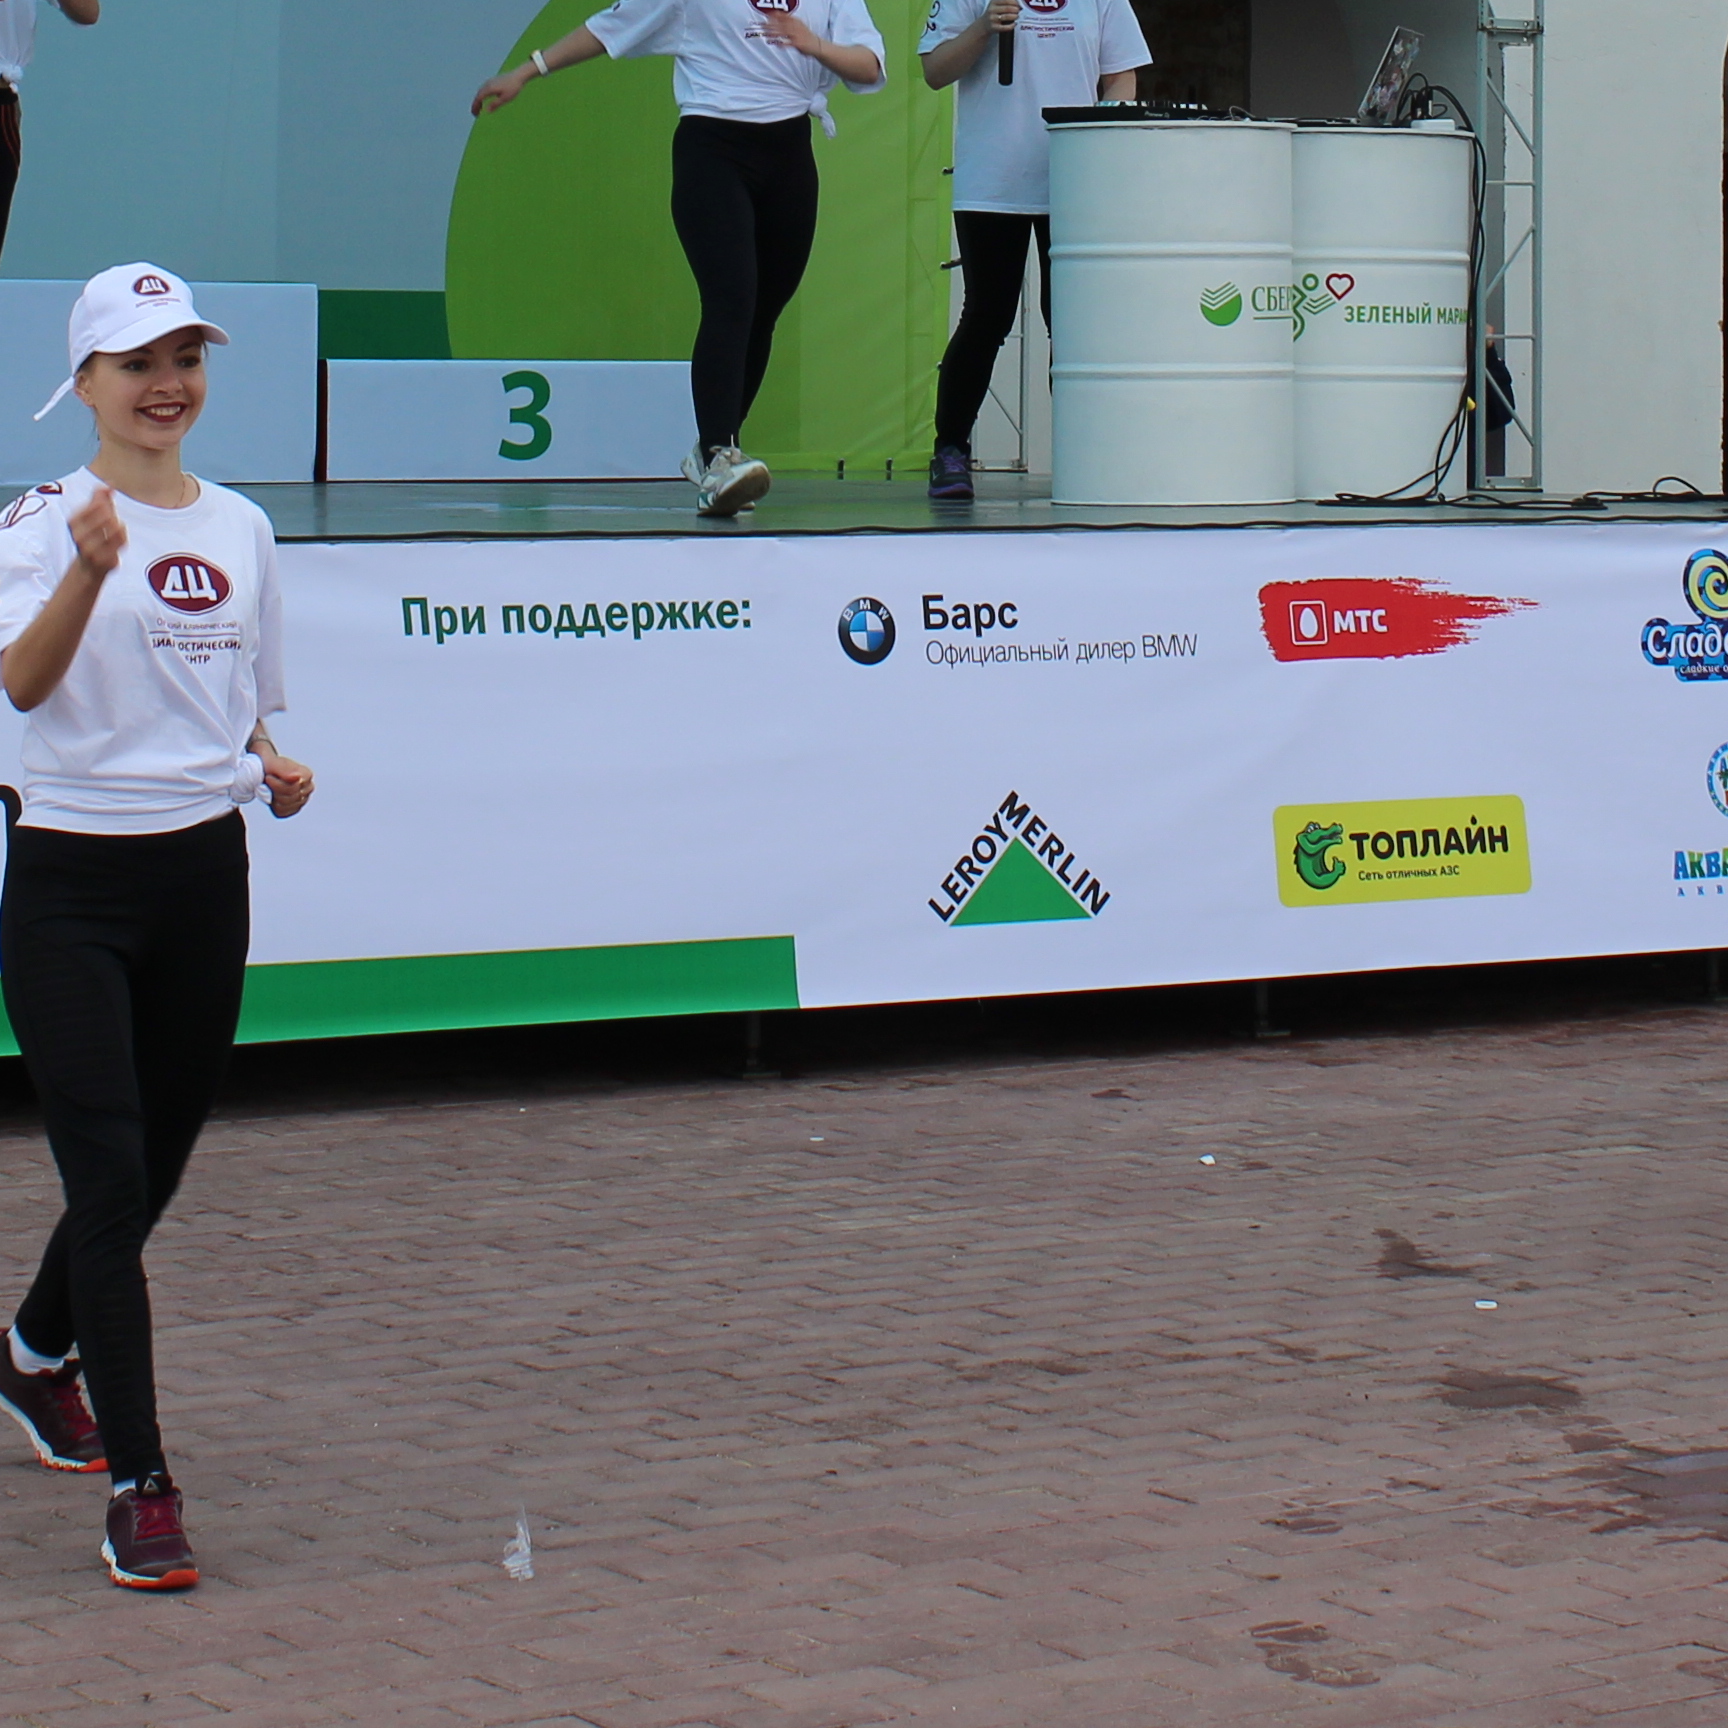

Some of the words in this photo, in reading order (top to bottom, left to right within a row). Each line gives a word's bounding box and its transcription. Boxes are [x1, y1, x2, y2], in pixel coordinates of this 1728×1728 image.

[1344, 302, 1432, 324] ЗЕЛЕНЫЙ
[498, 370, 552, 461] 3
[160, 564, 218, 602] ДЦ
[401, 596, 487, 644] При
[501, 599, 752, 640] поддержке:
[842, 599, 890, 622] BMW
[922, 594, 1019, 638] Барс
[1333, 608, 1388, 634] МТС
[925, 637, 1069, 669] Официальный
[1075, 639, 1136, 665] дилер
[1142, 633, 1198, 659] BMW
[1680, 661, 1720, 674] сладкие
[927, 811, 1009, 923] LEROY
[998, 789, 1111, 916] MERLIN
[1349, 814, 1509, 861] ТОПЛАЙН
[1358, 869, 1384, 882] Сеть
[1386, 868, 1438, 880] отличных
[1440, 865, 1461, 876] АЗС
